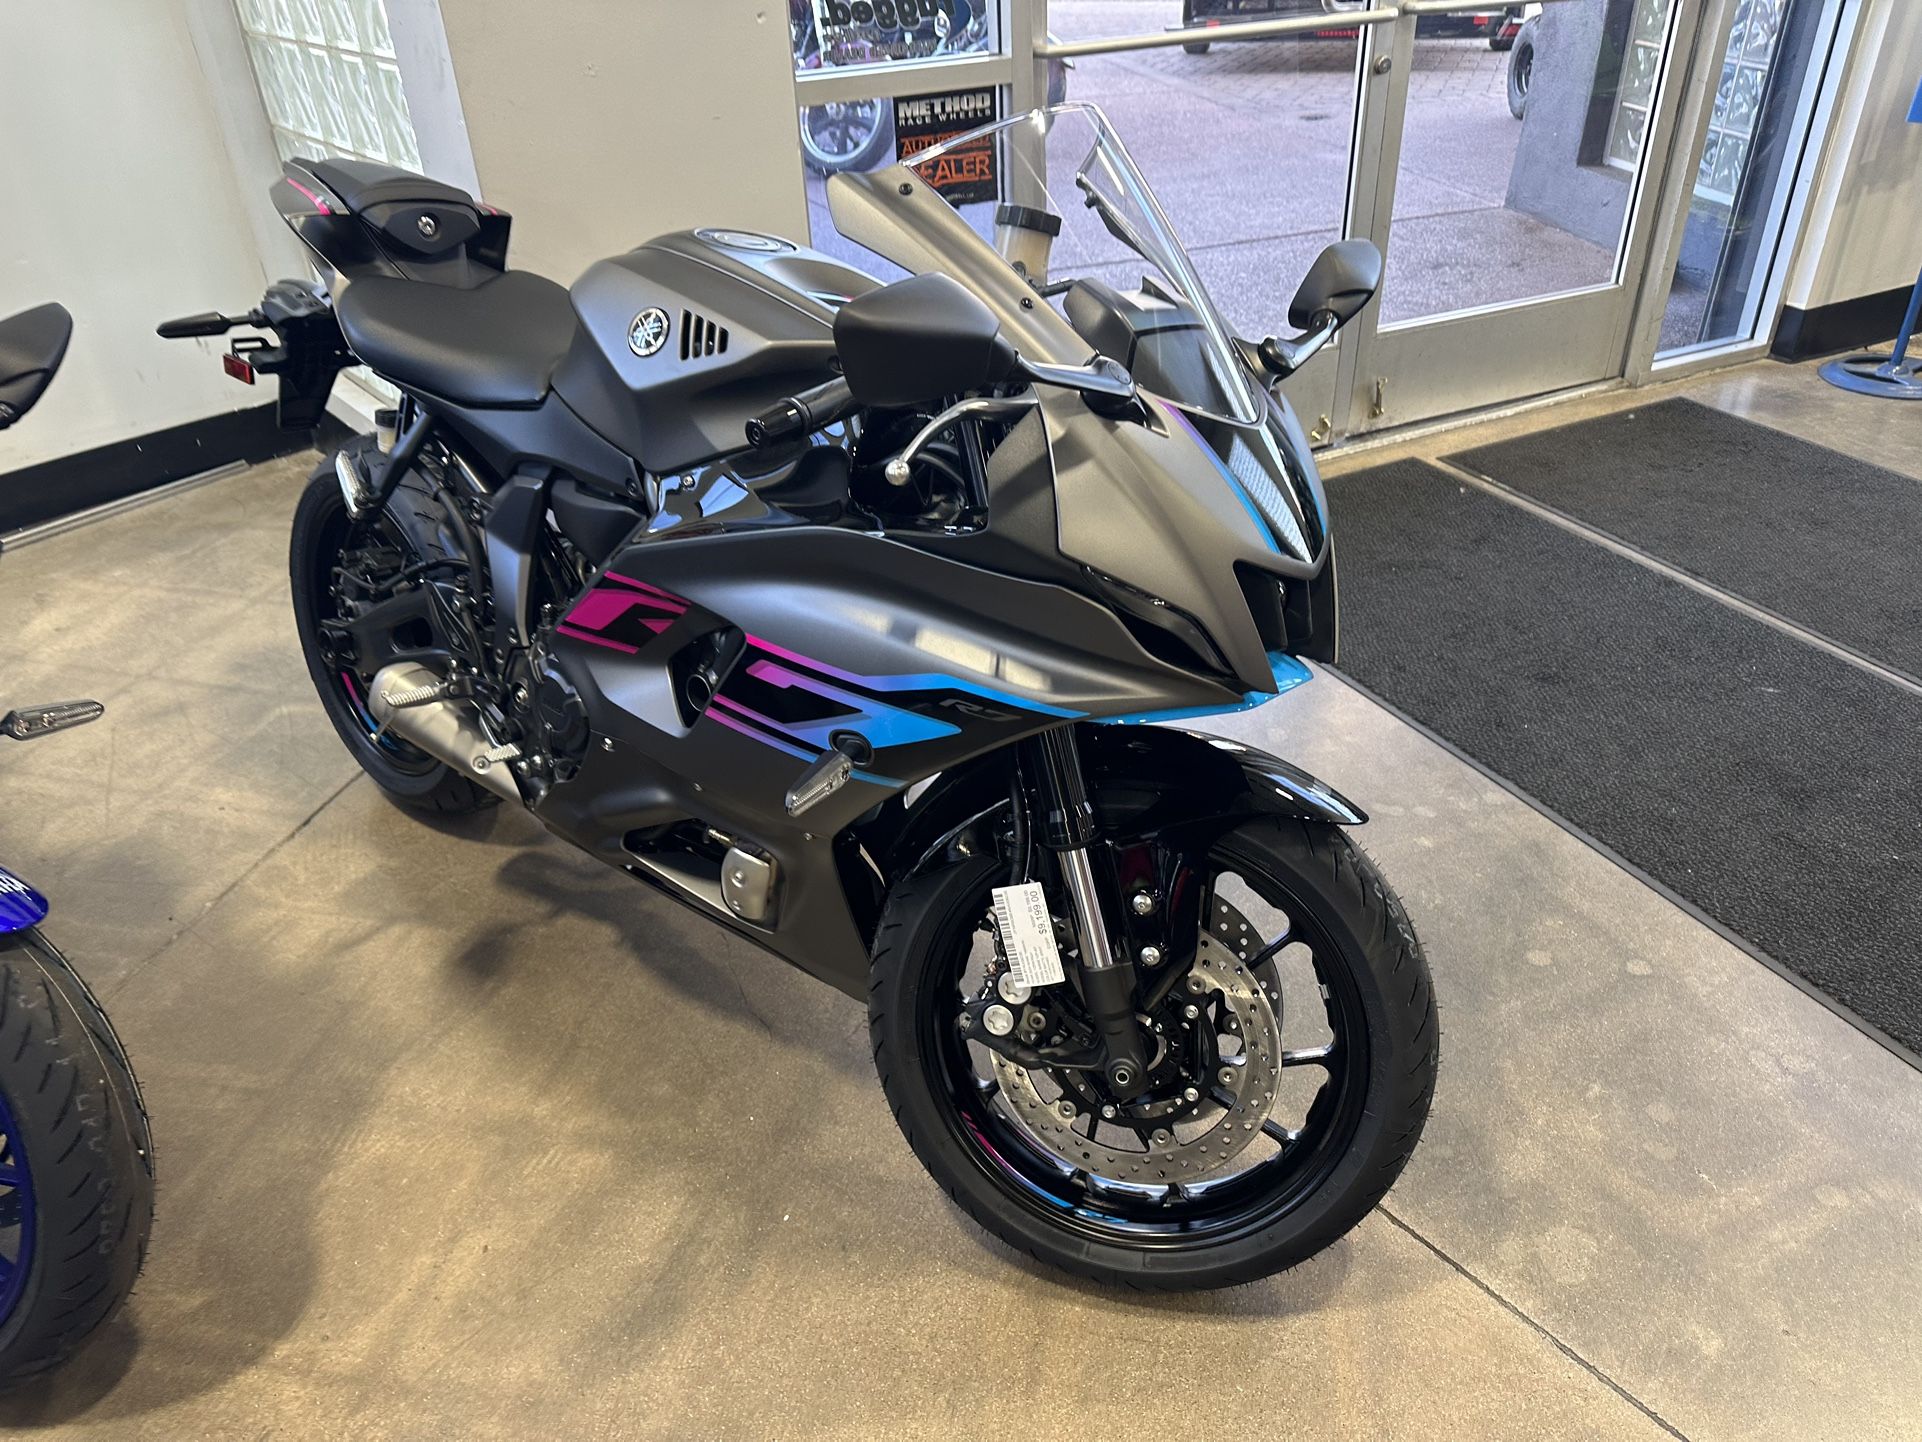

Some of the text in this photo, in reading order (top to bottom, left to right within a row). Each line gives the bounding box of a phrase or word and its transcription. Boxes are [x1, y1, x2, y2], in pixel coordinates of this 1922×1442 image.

[898, 93, 991, 118] METHOD
[938, 107, 991, 122] WHEELS
[919, 154, 990, 182] EALER
[1028, 889, 1048, 935] $9,199.00
